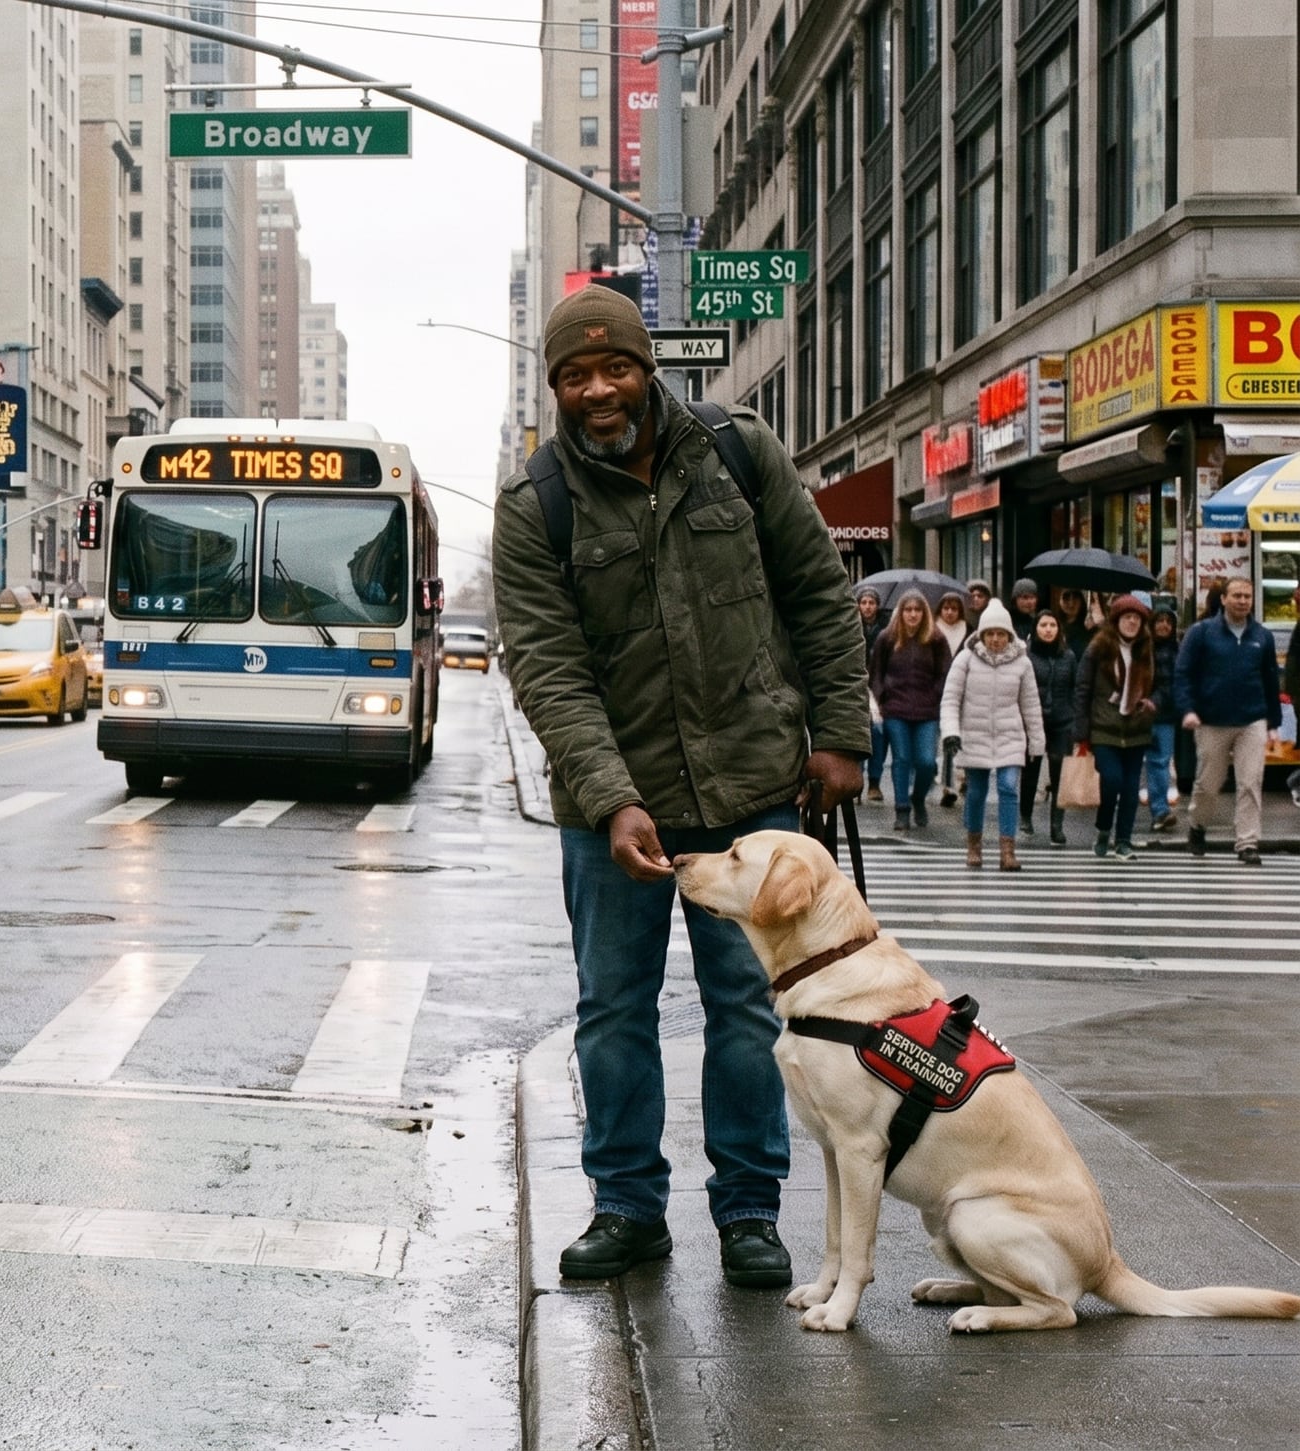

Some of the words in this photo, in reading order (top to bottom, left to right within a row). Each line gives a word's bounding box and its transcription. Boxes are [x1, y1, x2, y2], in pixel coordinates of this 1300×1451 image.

[204, 119, 373, 154] Broadway
[697, 256, 760, 280] Times
[769, 255, 796, 282] Sq
[696, 290, 742, 315] 45th
[751, 290, 774, 315] St
[681, 341, 716, 356] WAY
[1073, 320, 1154, 402] BODEGA
[160, 449, 211, 478] M42
[231, 451, 302, 479] TIMES
[309, 452, 342, 480] SQ
[243, 652, 264, 666] MTA
[879, 1042, 896, 1057] IN
[937, 1062, 964, 1083] DOG
